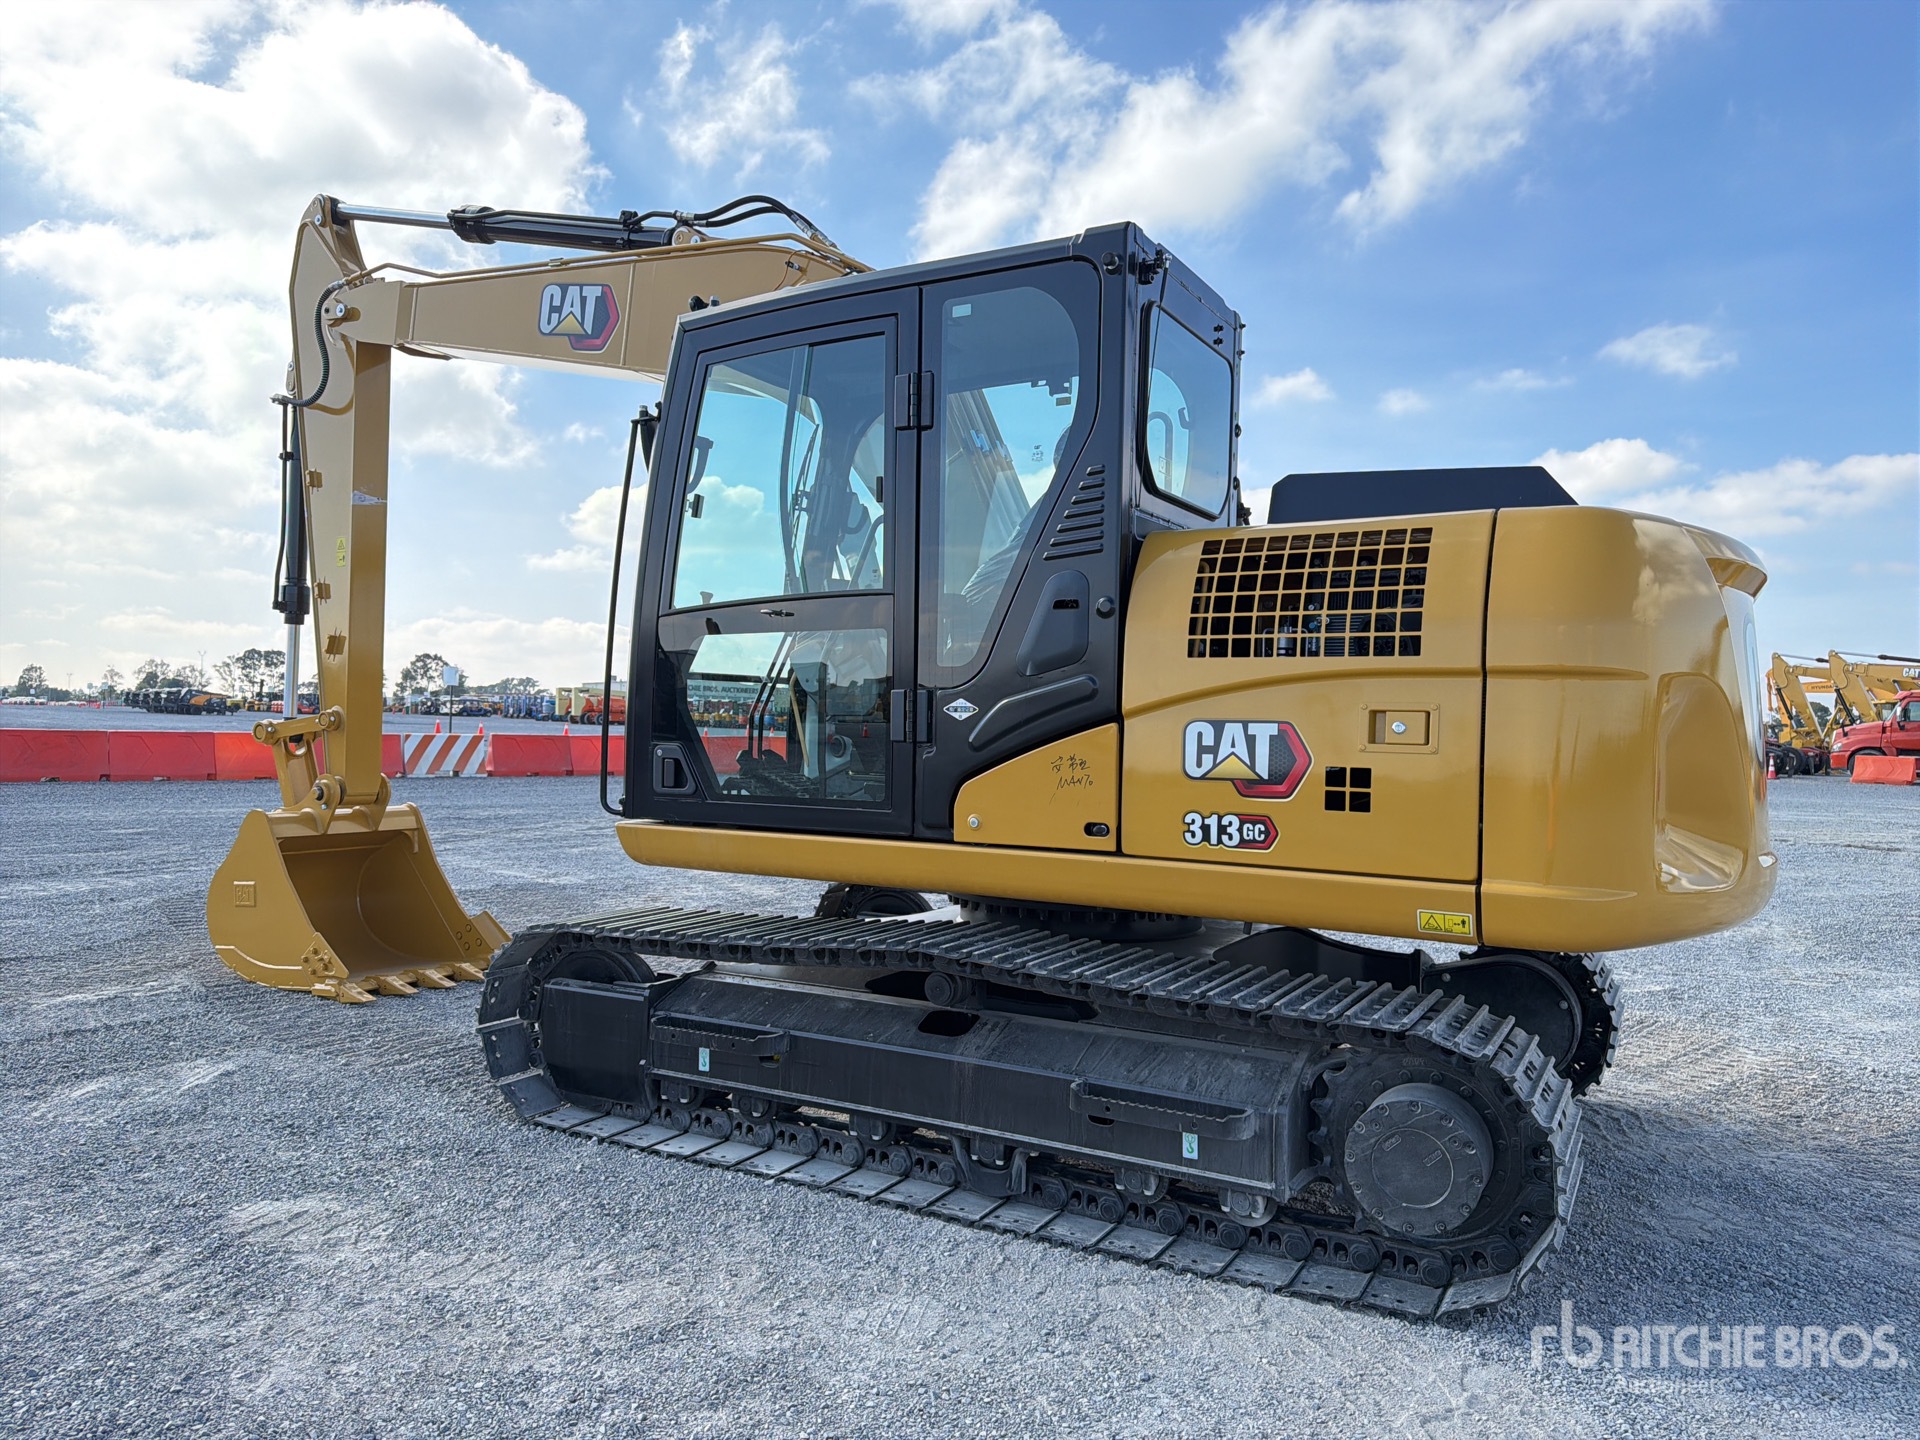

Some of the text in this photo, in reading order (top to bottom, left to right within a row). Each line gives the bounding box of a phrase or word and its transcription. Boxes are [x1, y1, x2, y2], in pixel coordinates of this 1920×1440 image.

[540, 285, 602, 335] CAT
[1902, 667, 1920, 678] CAT
[1184, 720, 1279, 781] CAT
[1184, 812, 1266, 848] 313 GC
